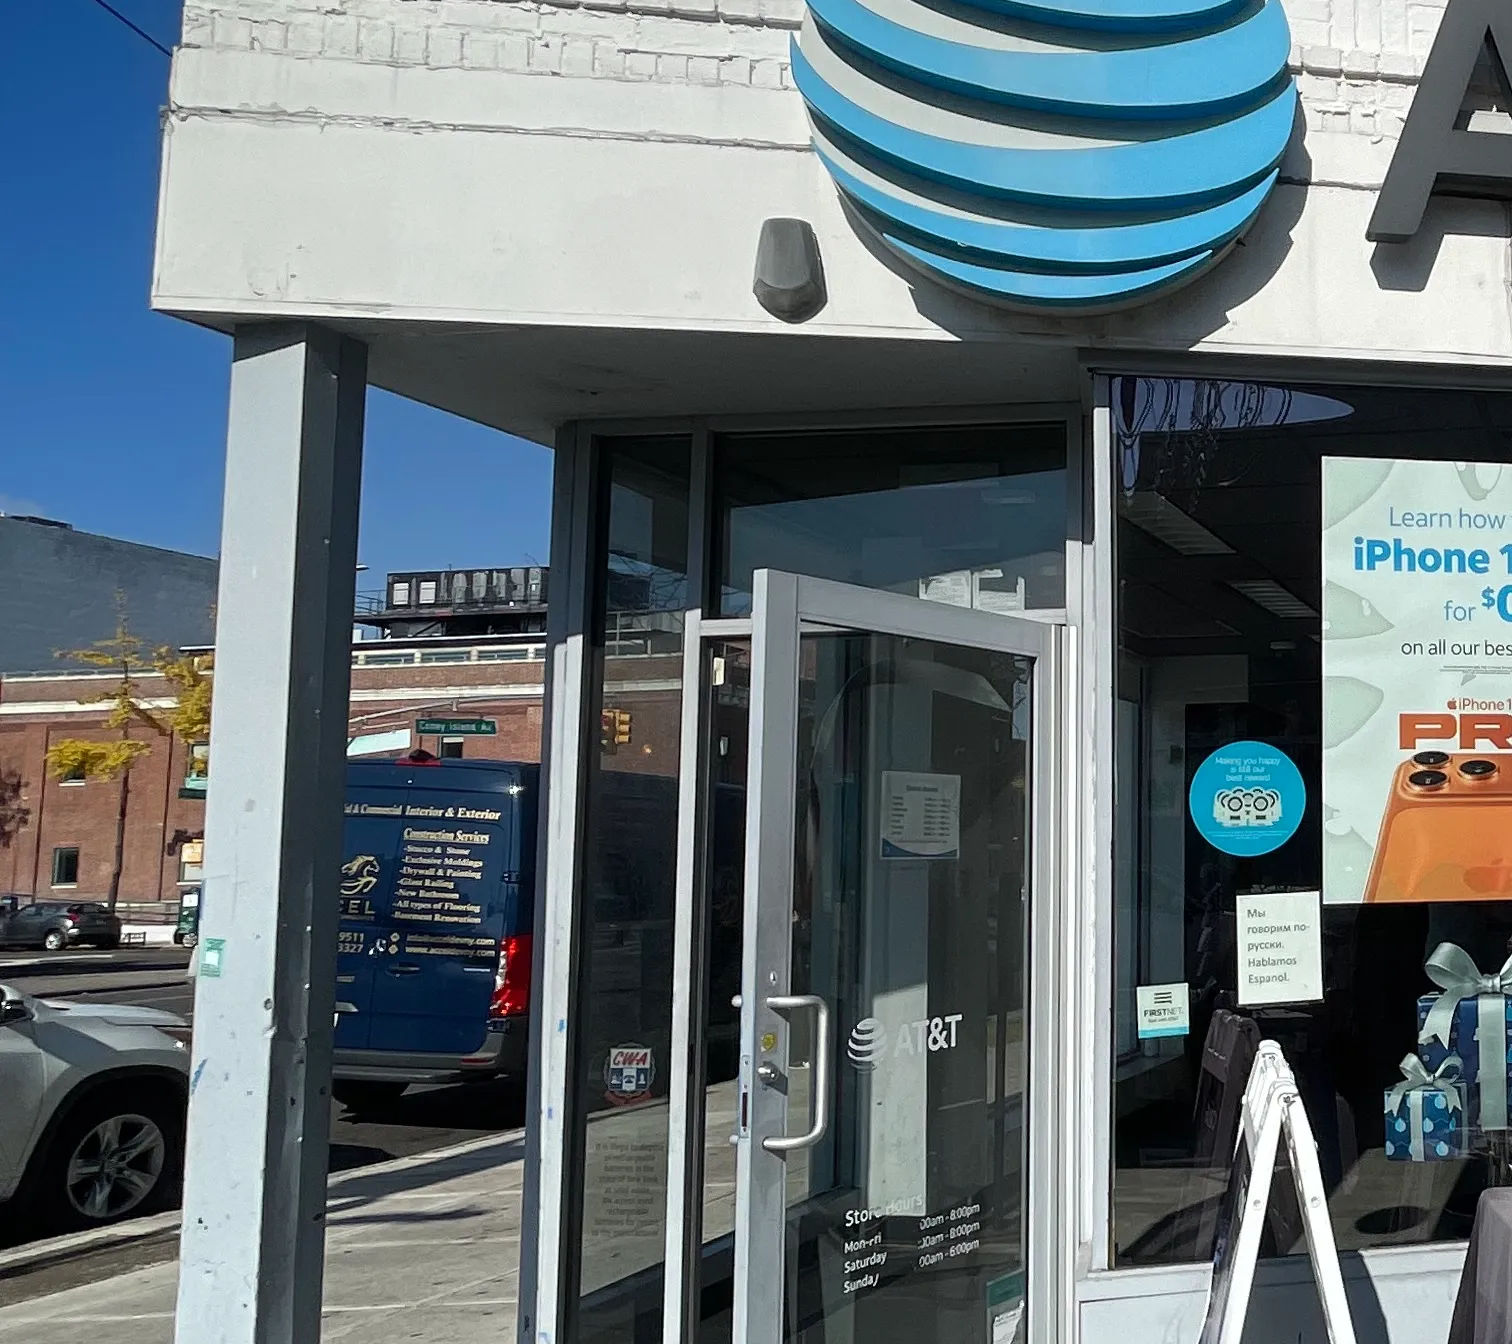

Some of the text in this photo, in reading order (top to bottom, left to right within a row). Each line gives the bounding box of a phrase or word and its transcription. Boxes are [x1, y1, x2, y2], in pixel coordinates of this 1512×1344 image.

[1389, 506, 1452, 529] Learn
[1459, 507, 1506, 529] how
[1353, 536, 1491, 574] iPhone
[1443, 599, 1477, 622] for
[1401, 642, 1424, 656] on
[1428, 639, 1447, 656] all
[1450, 642, 1480, 656] our
[1458, 697, 1505, 711] iPhone
[418, 720, 446, 733] Coney
[449, 721, 476, 731] Island
[405, 805, 444, 818] Interior
[445, 807, 455, 818] &
[457, 807, 501, 820] Exterior
[456, 829, 490, 844] Services
[1247, 908, 1266, 918] Мы
[1247, 923, 1292, 935] говорим
[1248, 957, 1298, 968] Hablamos
[894, 1014, 962, 1058] AT&T
[612, 1051, 649, 1066] CWA
[844, 1251, 888, 1274] Saturday
